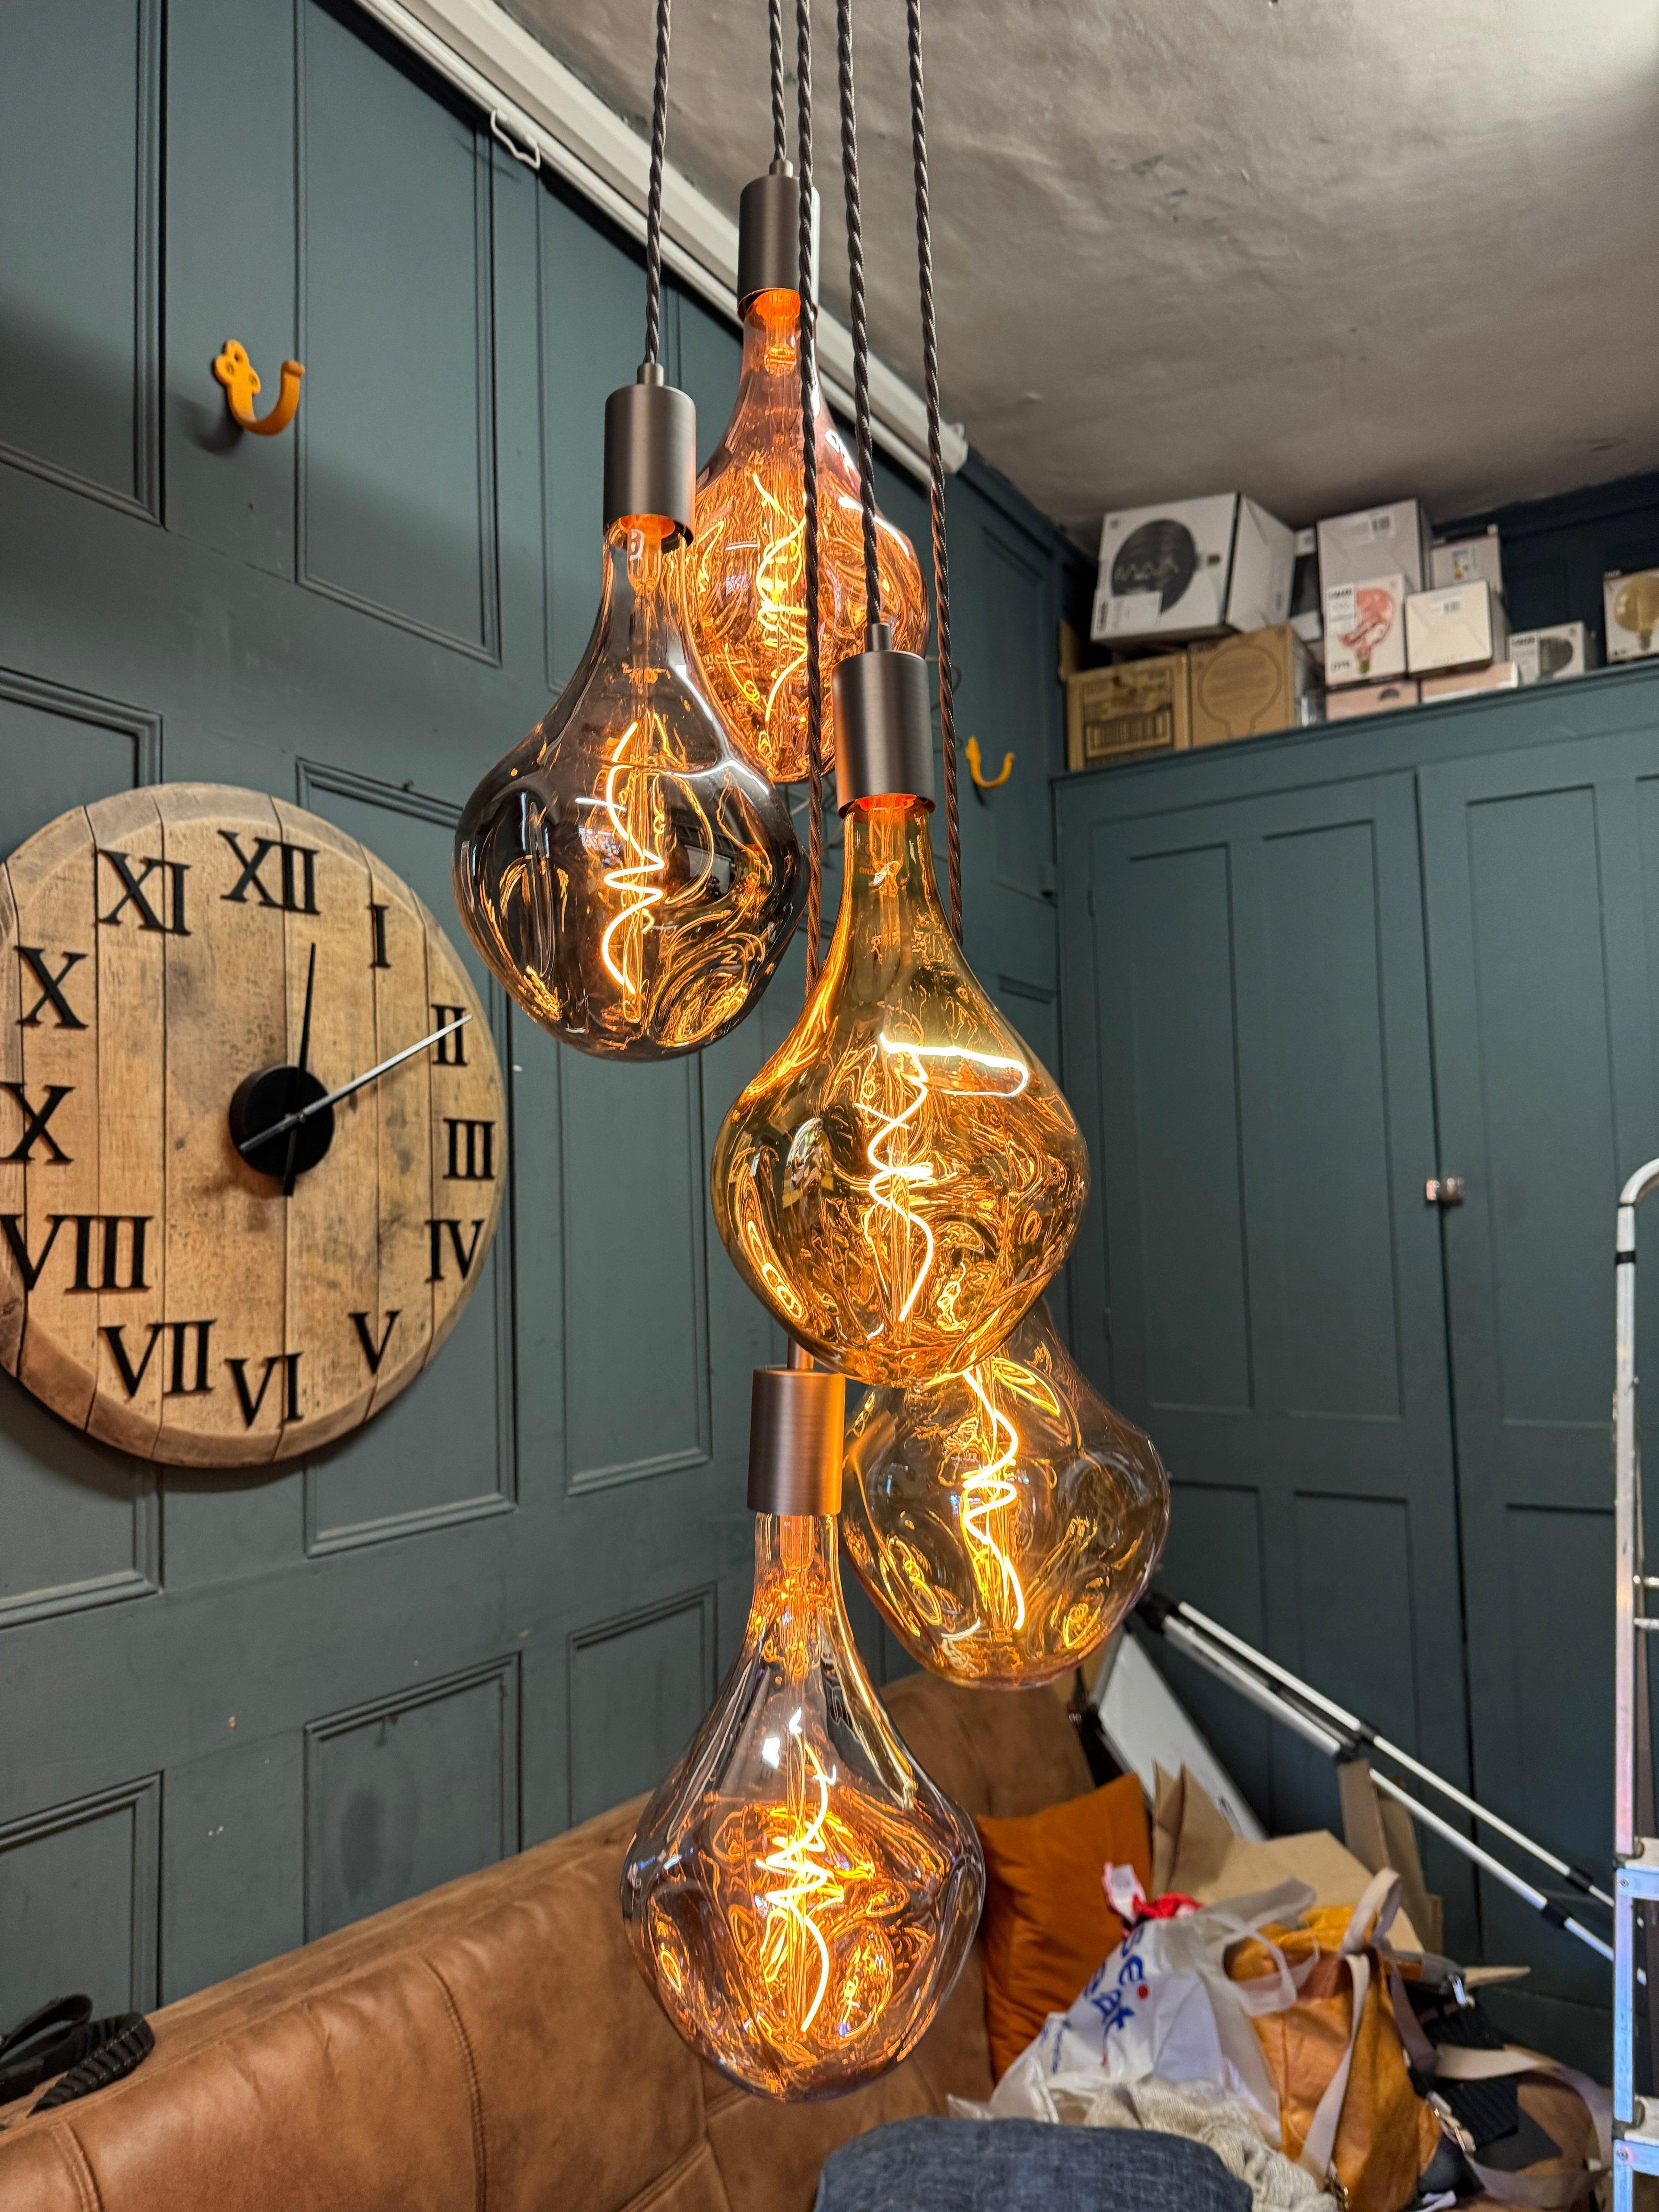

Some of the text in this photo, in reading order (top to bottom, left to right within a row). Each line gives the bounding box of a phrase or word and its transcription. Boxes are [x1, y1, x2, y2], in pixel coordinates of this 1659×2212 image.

[99, 849, 192, 935] XI
[219, 830, 320, 915] XII
[369, 904, 391, 969] I
[15, 946, 88, 1029] X
[431, 1005, 467, 1065] II
[0, 1081, 75, 1163] X
[443, 1119, 494, 1180] III
[0, 1214, 153, 1292] VIII
[425, 1219, 483, 1283] IV
[99, 1320, 216, 1398] VII
[349, 1311, 400, 1374] V
[226, 1352, 304, 1429] VI
